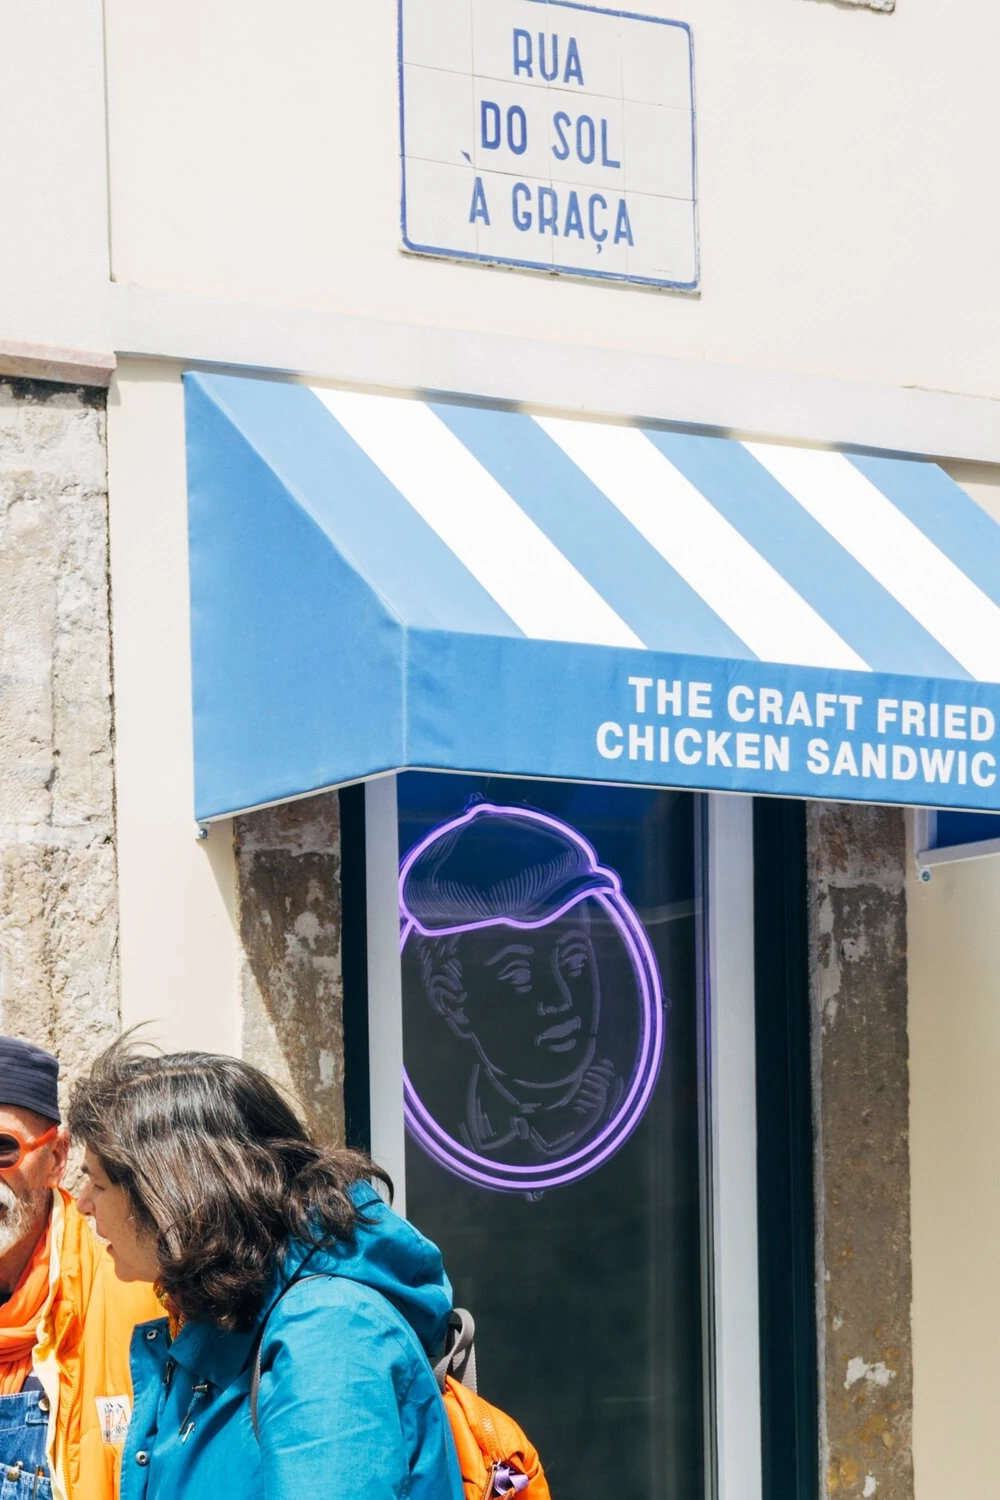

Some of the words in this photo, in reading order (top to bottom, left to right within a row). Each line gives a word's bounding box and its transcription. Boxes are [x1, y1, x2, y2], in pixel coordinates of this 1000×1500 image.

[512, 27, 585, 86] RUA
[481, 99, 527, 155] DO
[551, 111, 621, 169] SOL
[460, 150, 491, 226] À
[512, 182, 634, 254] GRAÇA
[628, 676, 713, 719] THE
[727, 685, 863, 731] CRAFT
[877, 698, 995, 742] FRIED
[596, 721, 790, 773] CHICKEN
